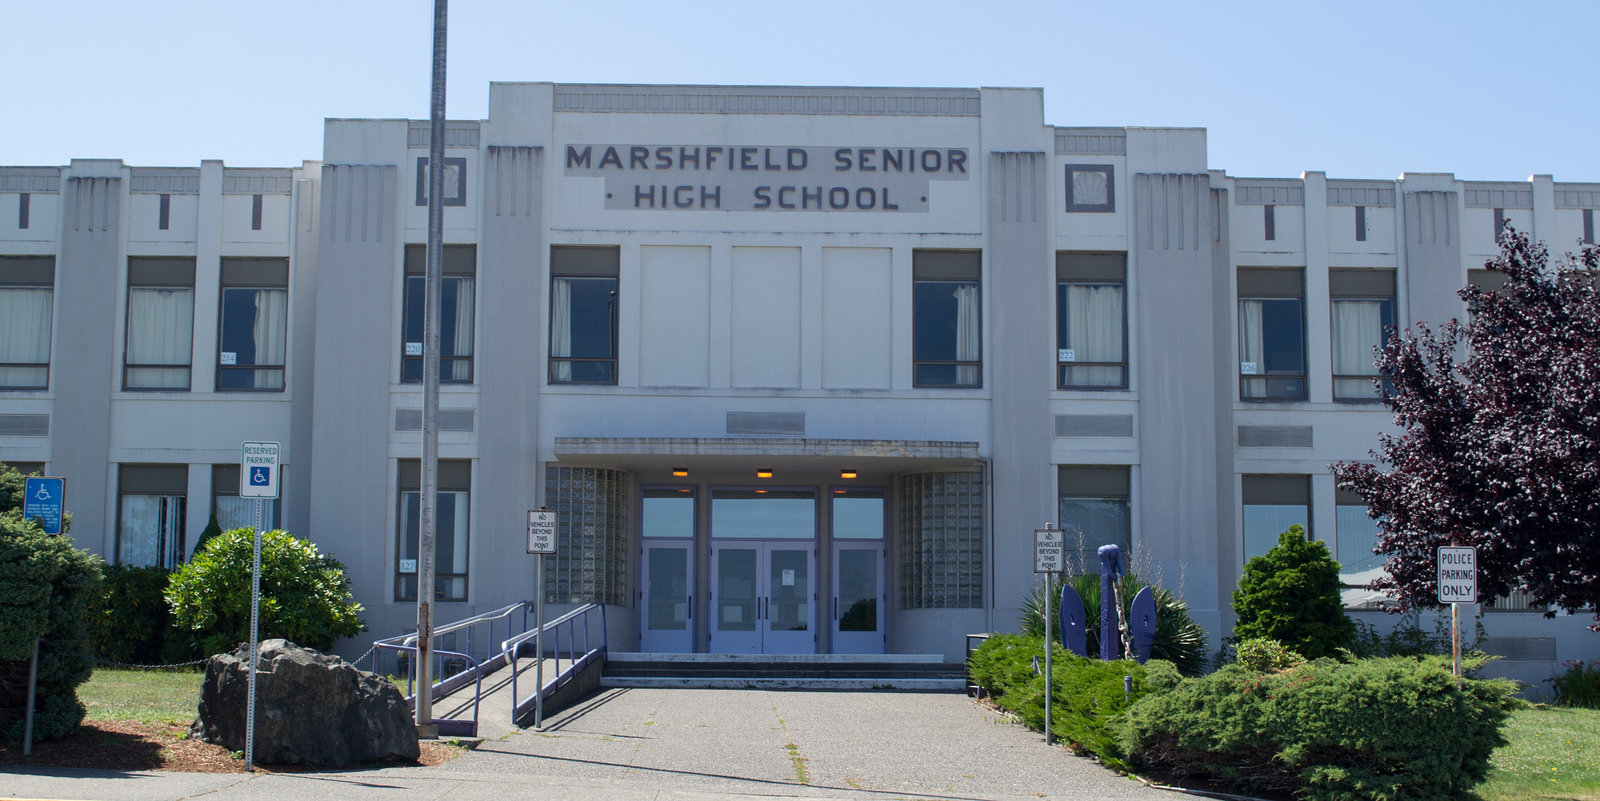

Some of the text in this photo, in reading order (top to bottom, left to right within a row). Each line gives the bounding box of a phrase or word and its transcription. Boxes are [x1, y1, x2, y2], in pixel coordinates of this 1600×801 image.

[567, 146, 967, 173] MARSHFIELD SENIOR
[635, 185, 899, 210] HIGH SCHOOL
[1060, 351, 1073, 359] 222
[1242, 364, 1256, 373] 226
[245, 447, 277, 455] RESERVED
[1442, 554, 1472, 564] POLICE
[1442, 570, 1473, 580] PARKING
[1443, 585, 1472, 596] ONLY
